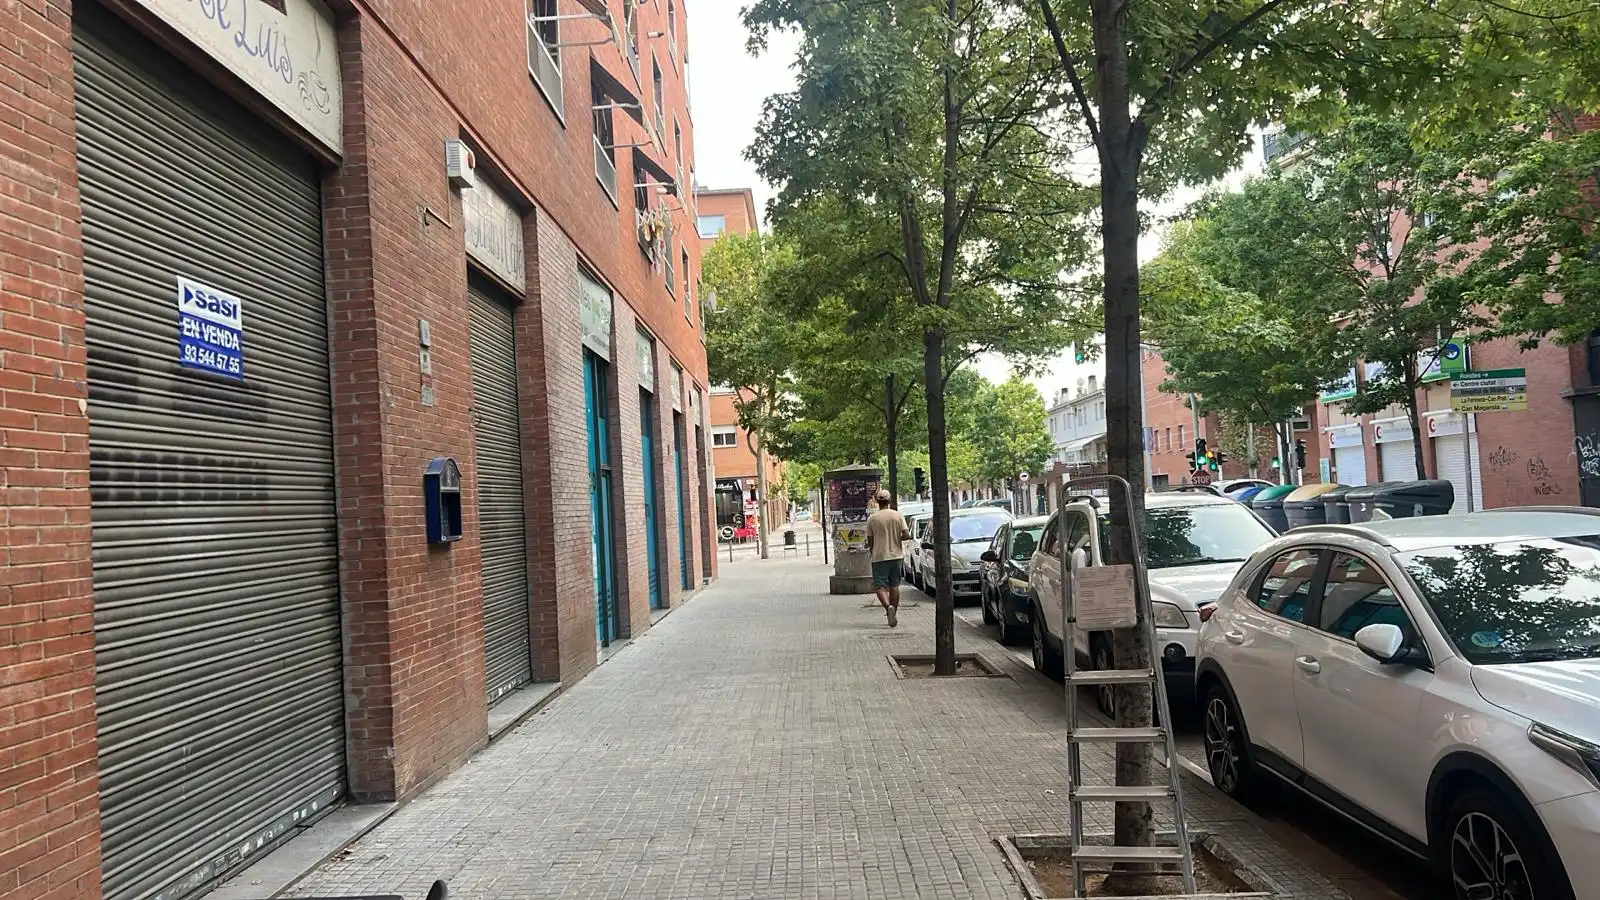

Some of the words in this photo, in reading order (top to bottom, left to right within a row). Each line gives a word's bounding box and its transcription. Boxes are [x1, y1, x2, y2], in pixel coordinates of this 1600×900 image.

[182, 317, 201, 339] EN
[202, 322, 240, 351] VENDA
[184, 344, 197, 361] 93
[198, 348, 215, 366] 544
[216, 353, 228, 370] 57
[229, 357, 240, 373] 55
[1192, 475, 1211, 485] STOP
